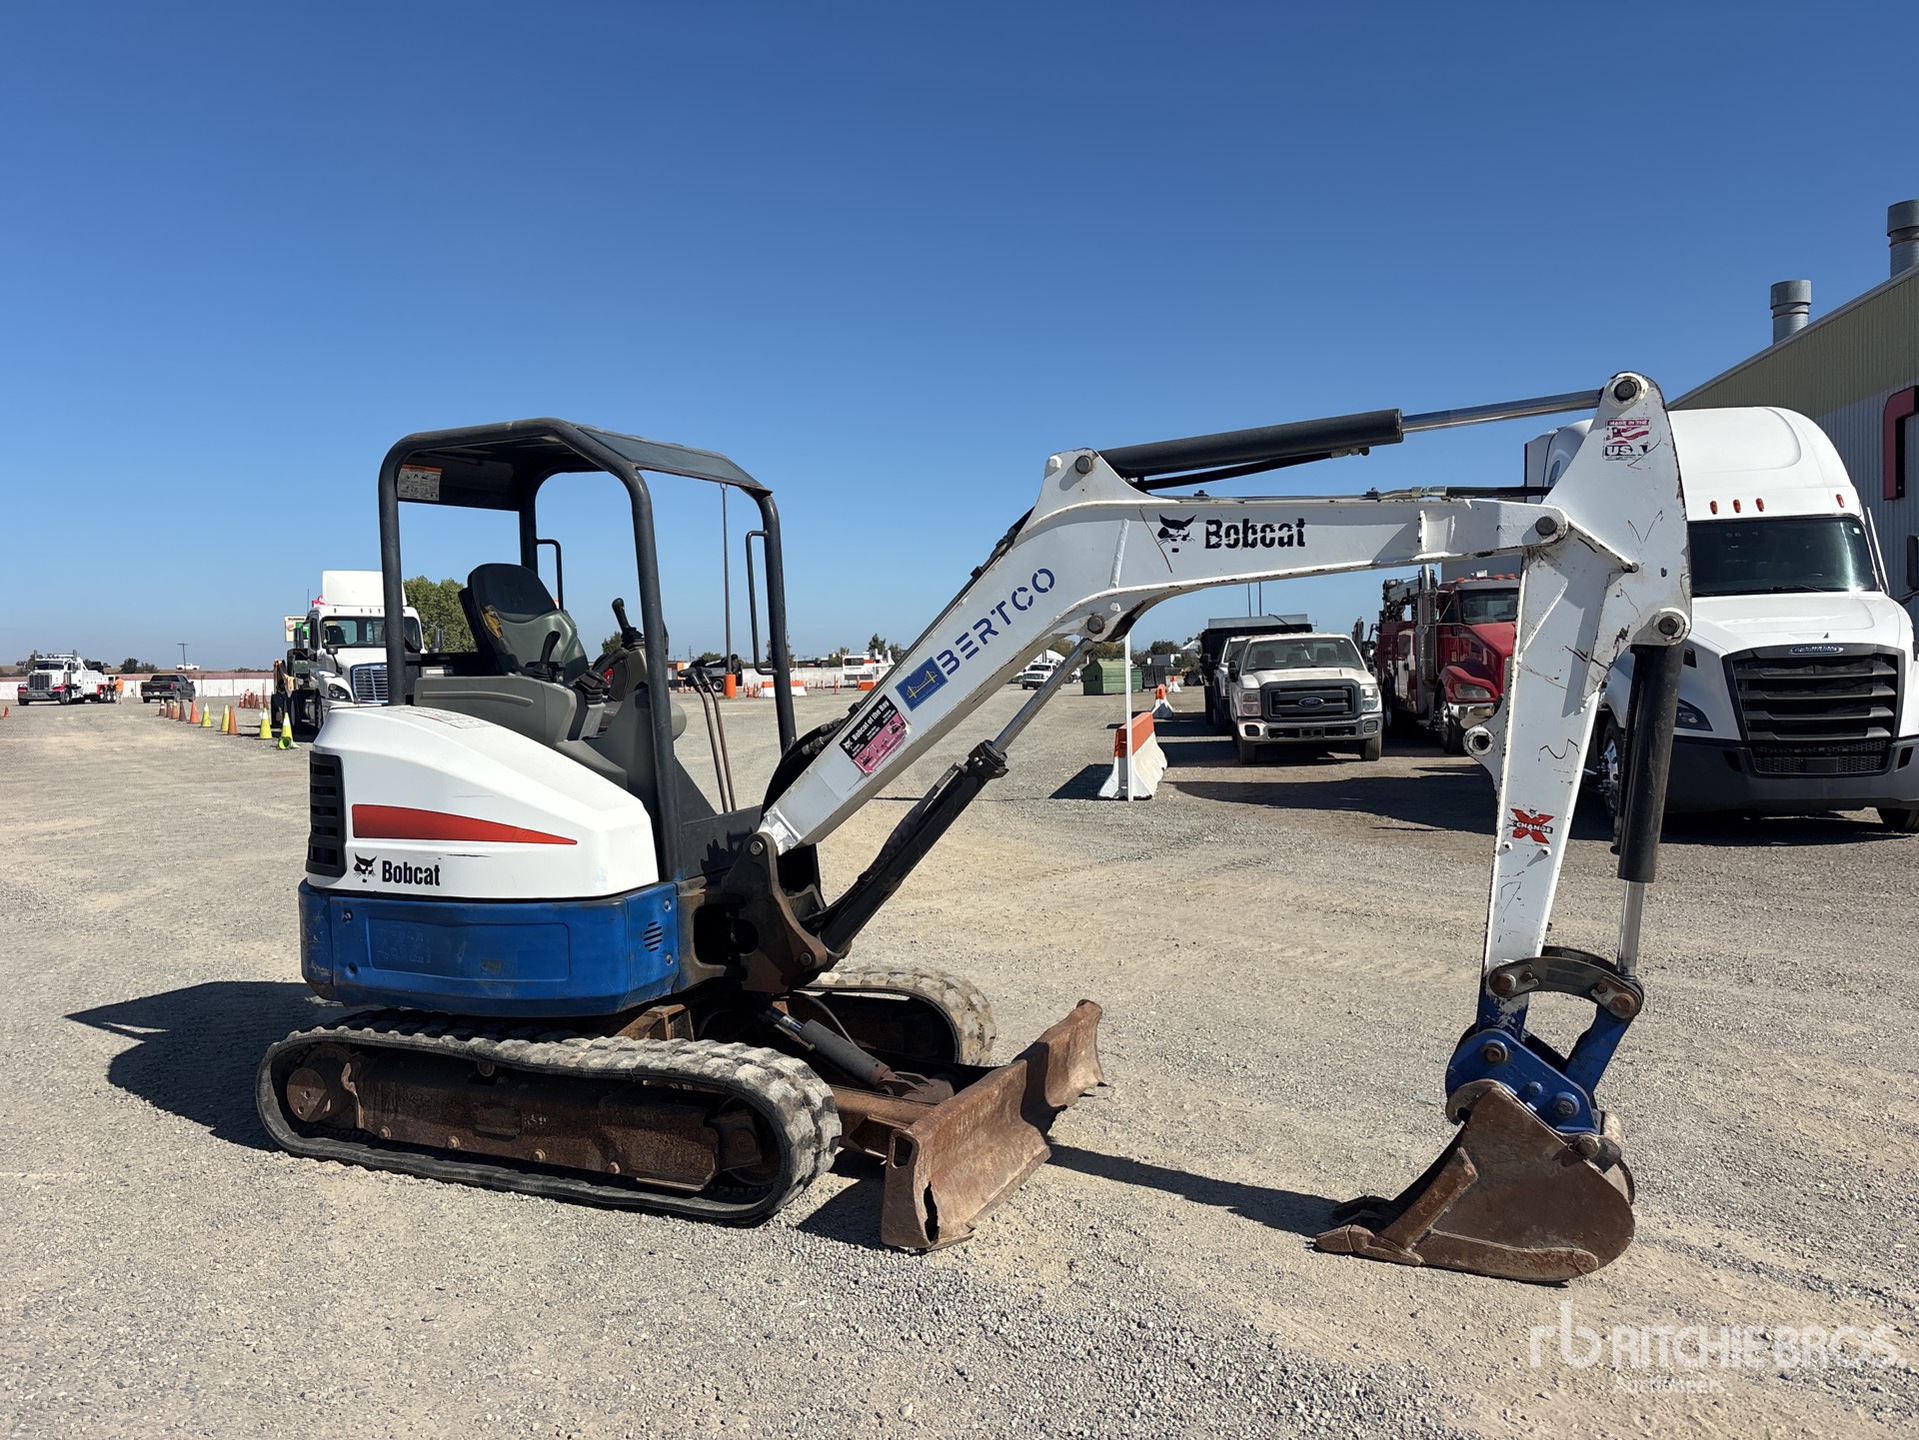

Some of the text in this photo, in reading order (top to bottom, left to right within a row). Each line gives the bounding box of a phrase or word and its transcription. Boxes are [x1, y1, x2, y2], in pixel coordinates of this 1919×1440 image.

[1205, 518, 1305, 549] Bobcat
[936, 568, 1055, 676] BERTCO
[851, 721, 870, 741] Bobcat
[382, 860, 440, 886] Bobcat
